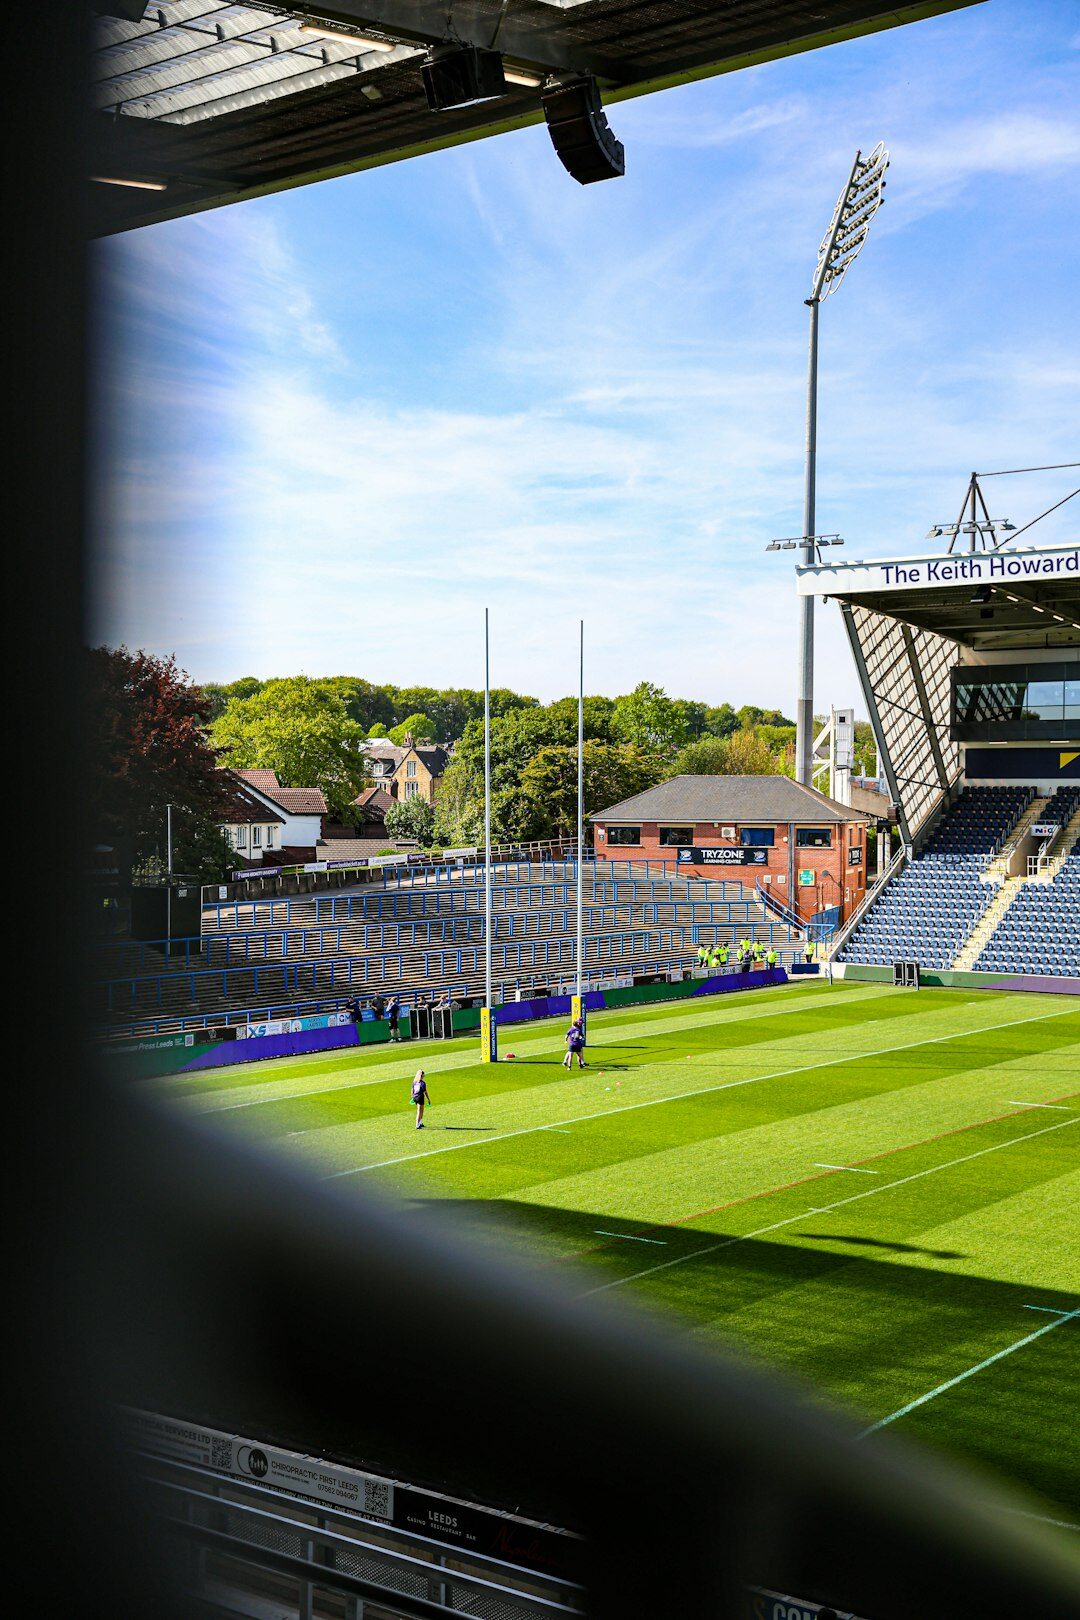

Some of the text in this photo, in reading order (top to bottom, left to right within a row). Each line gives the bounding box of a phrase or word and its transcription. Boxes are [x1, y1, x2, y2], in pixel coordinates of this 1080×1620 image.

[880, 551, 1079, 584] The Keith Howard
[701, 849, 744, 859] TRYZONE
[155, 1040, 173, 1048] Leeds
[165, 1425, 197, 1441] SERVICES
[197, 1434, 211, 1444] LTD
[271, 1461, 318, 1481] CHIROPRACTIC
[319, 1474, 336, 1486] FIRST
[338, 1479, 359, 1493] LEEDS
[406, 1515, 477, 1541] CASINO RESTAURANT BAR
[428, 1510, 458, 1528] LEEDS
